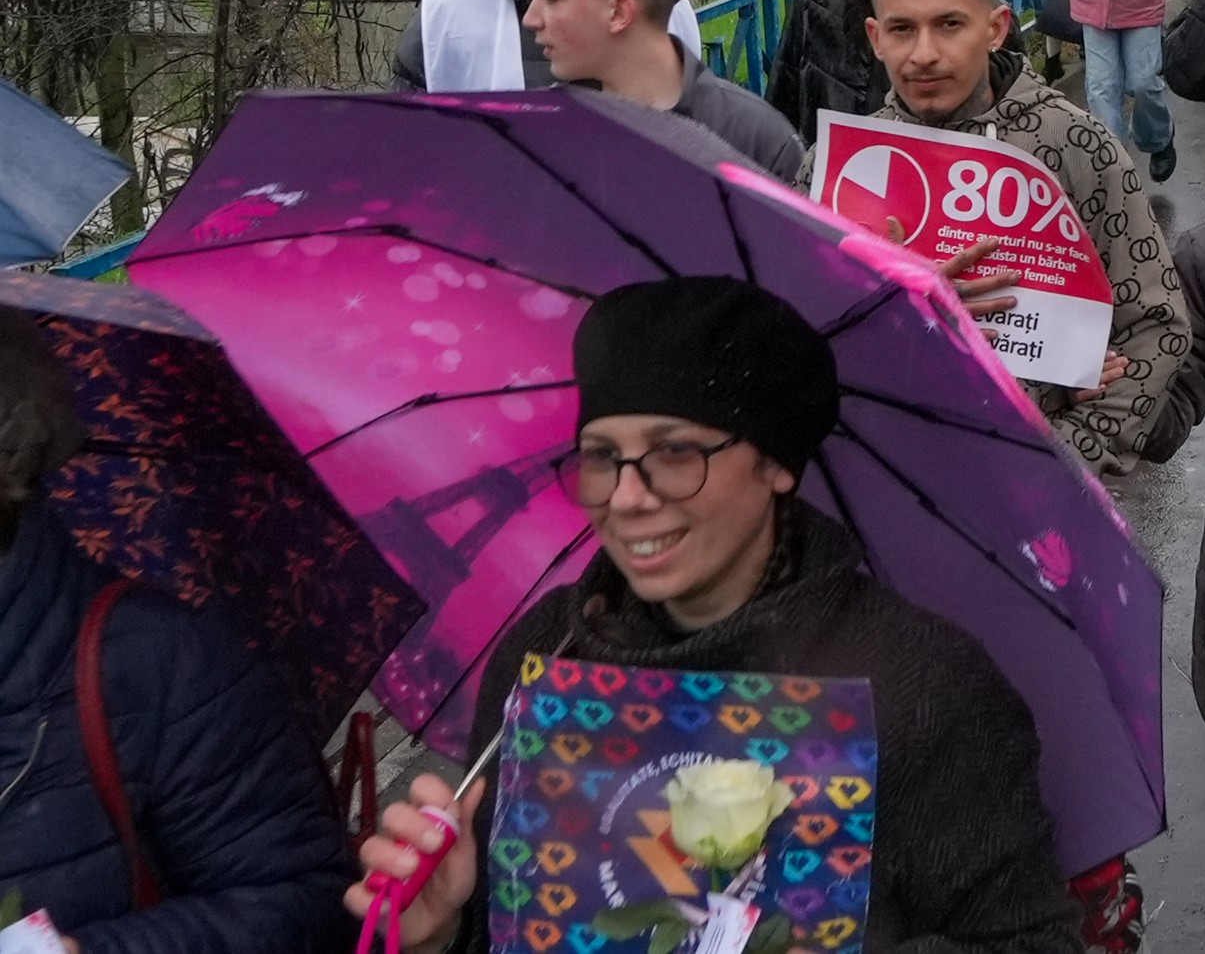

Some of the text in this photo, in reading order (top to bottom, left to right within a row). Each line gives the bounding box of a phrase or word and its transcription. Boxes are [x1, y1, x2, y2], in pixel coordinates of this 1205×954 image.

[941, 159, 1081, 242] 80%
[938, 226, 1090, 263] dintre avrturi nu s-ar face
[1019, 254, 1036, 264] un
[1038, 255, 1078, 272] bărbat
[1024, 268, 1066, 286] femeia
[990, 334, 1044, 362] vărați
